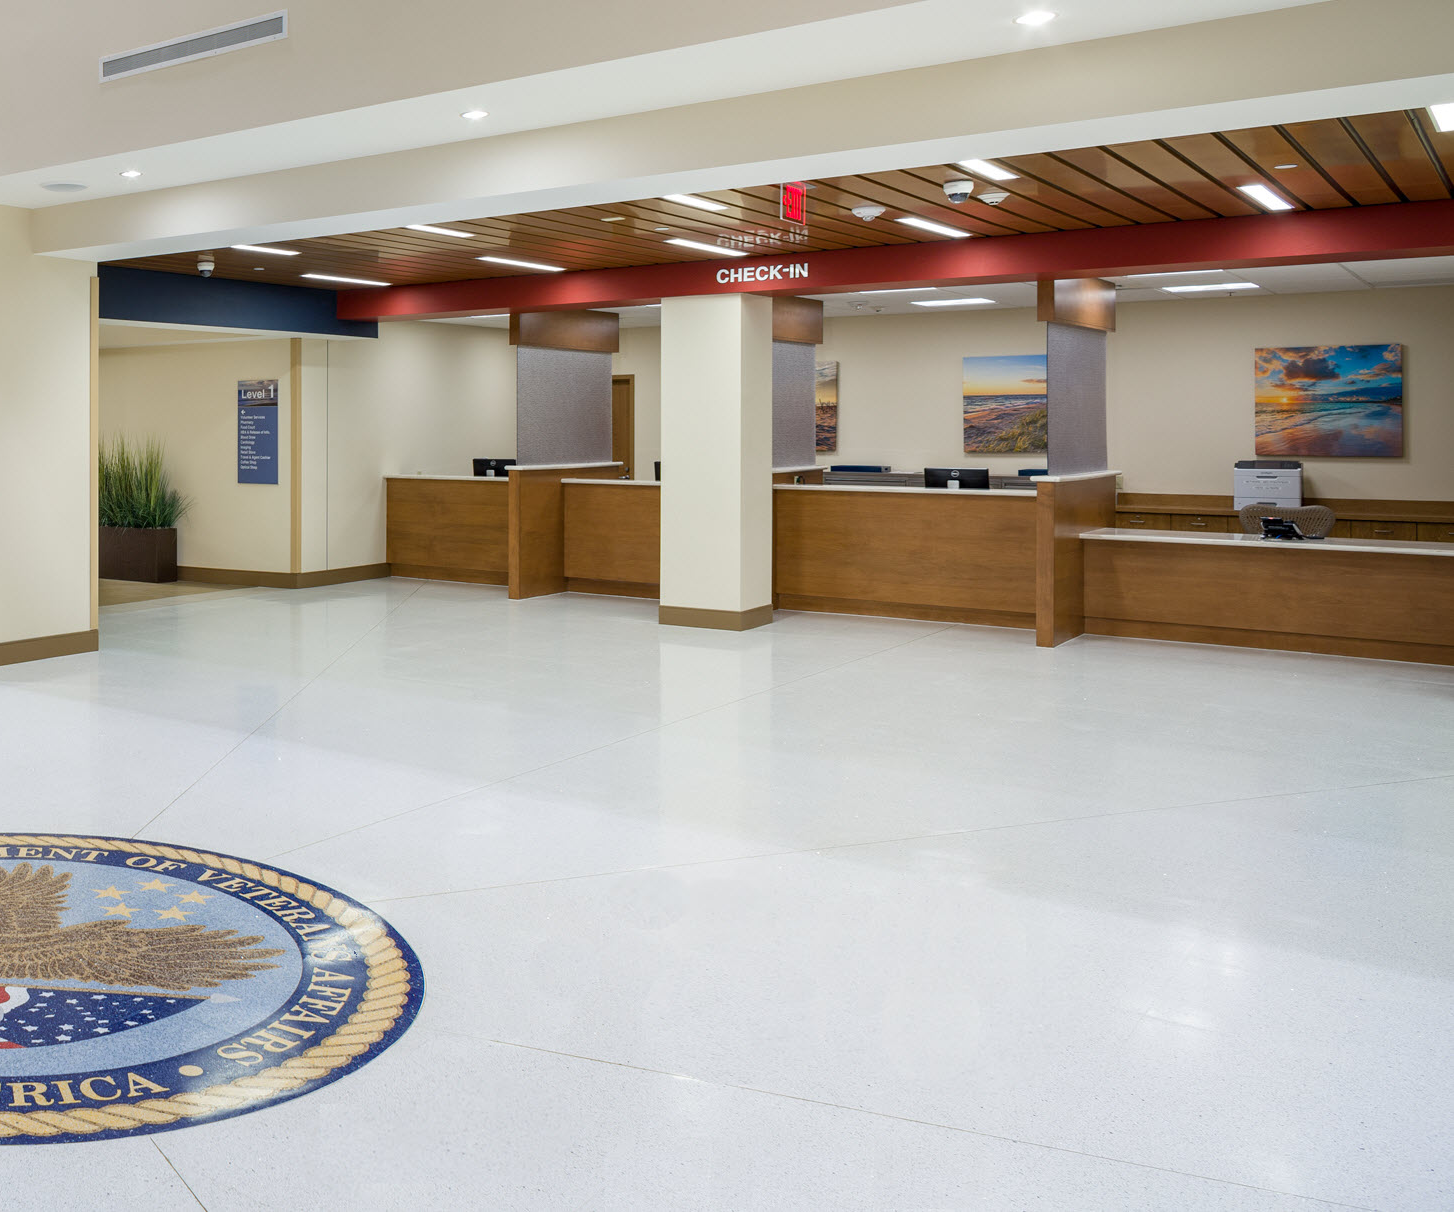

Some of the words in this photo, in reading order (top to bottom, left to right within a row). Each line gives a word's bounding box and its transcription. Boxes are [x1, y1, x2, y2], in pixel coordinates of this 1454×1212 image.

[716, 263, 808, 283] CHECK-IN
[241, 389, 265, 399] Level
[268, 384, 274, 398] 1
[125, 856, 188, 873] OF
[217, 967, 355, 1067] AFFAIRS
